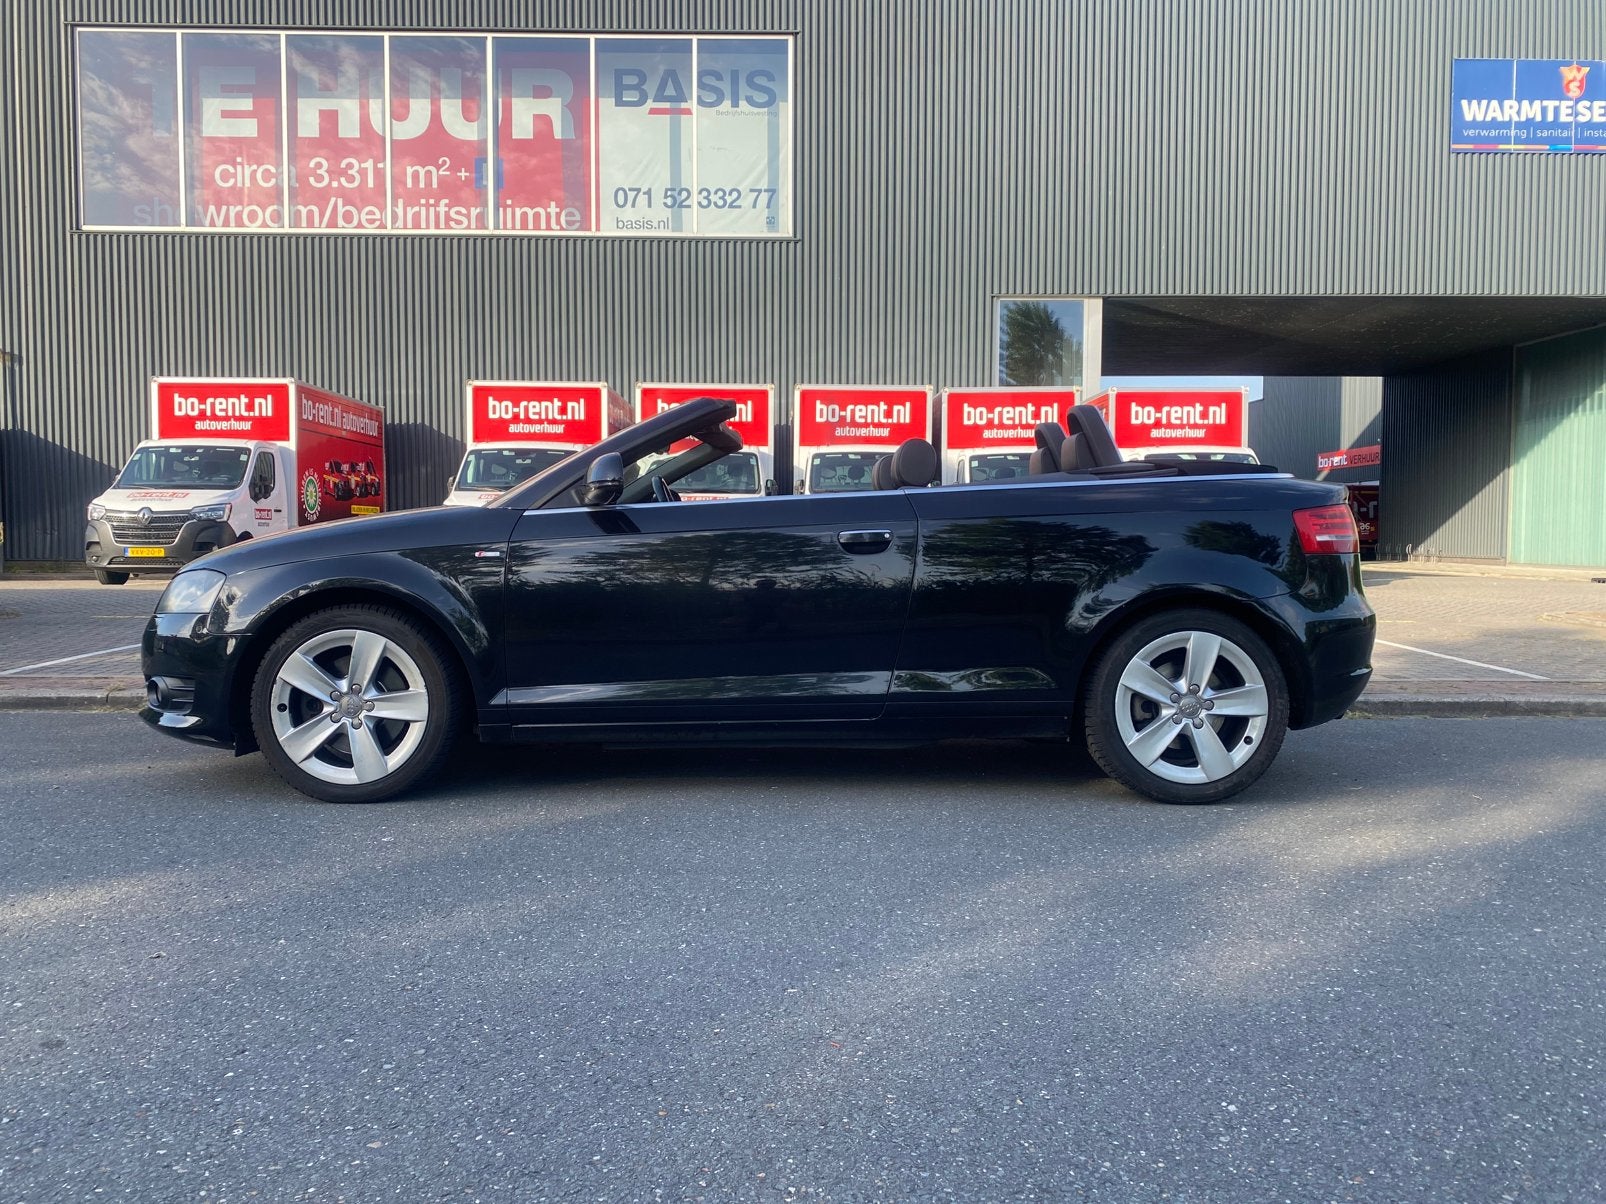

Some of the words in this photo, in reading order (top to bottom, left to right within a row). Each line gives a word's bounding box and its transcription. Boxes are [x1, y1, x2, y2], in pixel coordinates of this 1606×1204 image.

[614, 68, 777, 109] BASIS
[297, 66, 576, 141] HUUR
[1461, 99, 1606, 122] WARMTESE
[1463, 128, 1527, 138] verwarming
[214, 157, 298, 189] circa
[308, 157, 389, 188] 3.31
[613, 187, 652, 209] 071
[663, 187, 692, 209] 52
[697, 187, 742, 209] 332
[750, 188, 777, 209] 77
[616, 217, 670, 230] basis.nl
[174, 393, 273, 417] bo-rent.nl
[301, 393, 342, 428] bo-rent.nl
[488, 396, 585, 421] bo-rent.nl
[815, 399, 911, 424] bo-rent.nl
[963, 402, 1059, 425] bo-rent.nl
[1130, 402, 1226, 425] bo-rent.nl
[195, 418, 253, 431] autoverhuur
[508, 421, 565, 434] autoverhuur
[835, 424, 890, 437] autoverhuur
[983, 426, 1036, 439] autoverhuu
[1150, 426, 1207, 438] autoverhuur
[1349, 450, 1380, 465] VERHUUR
